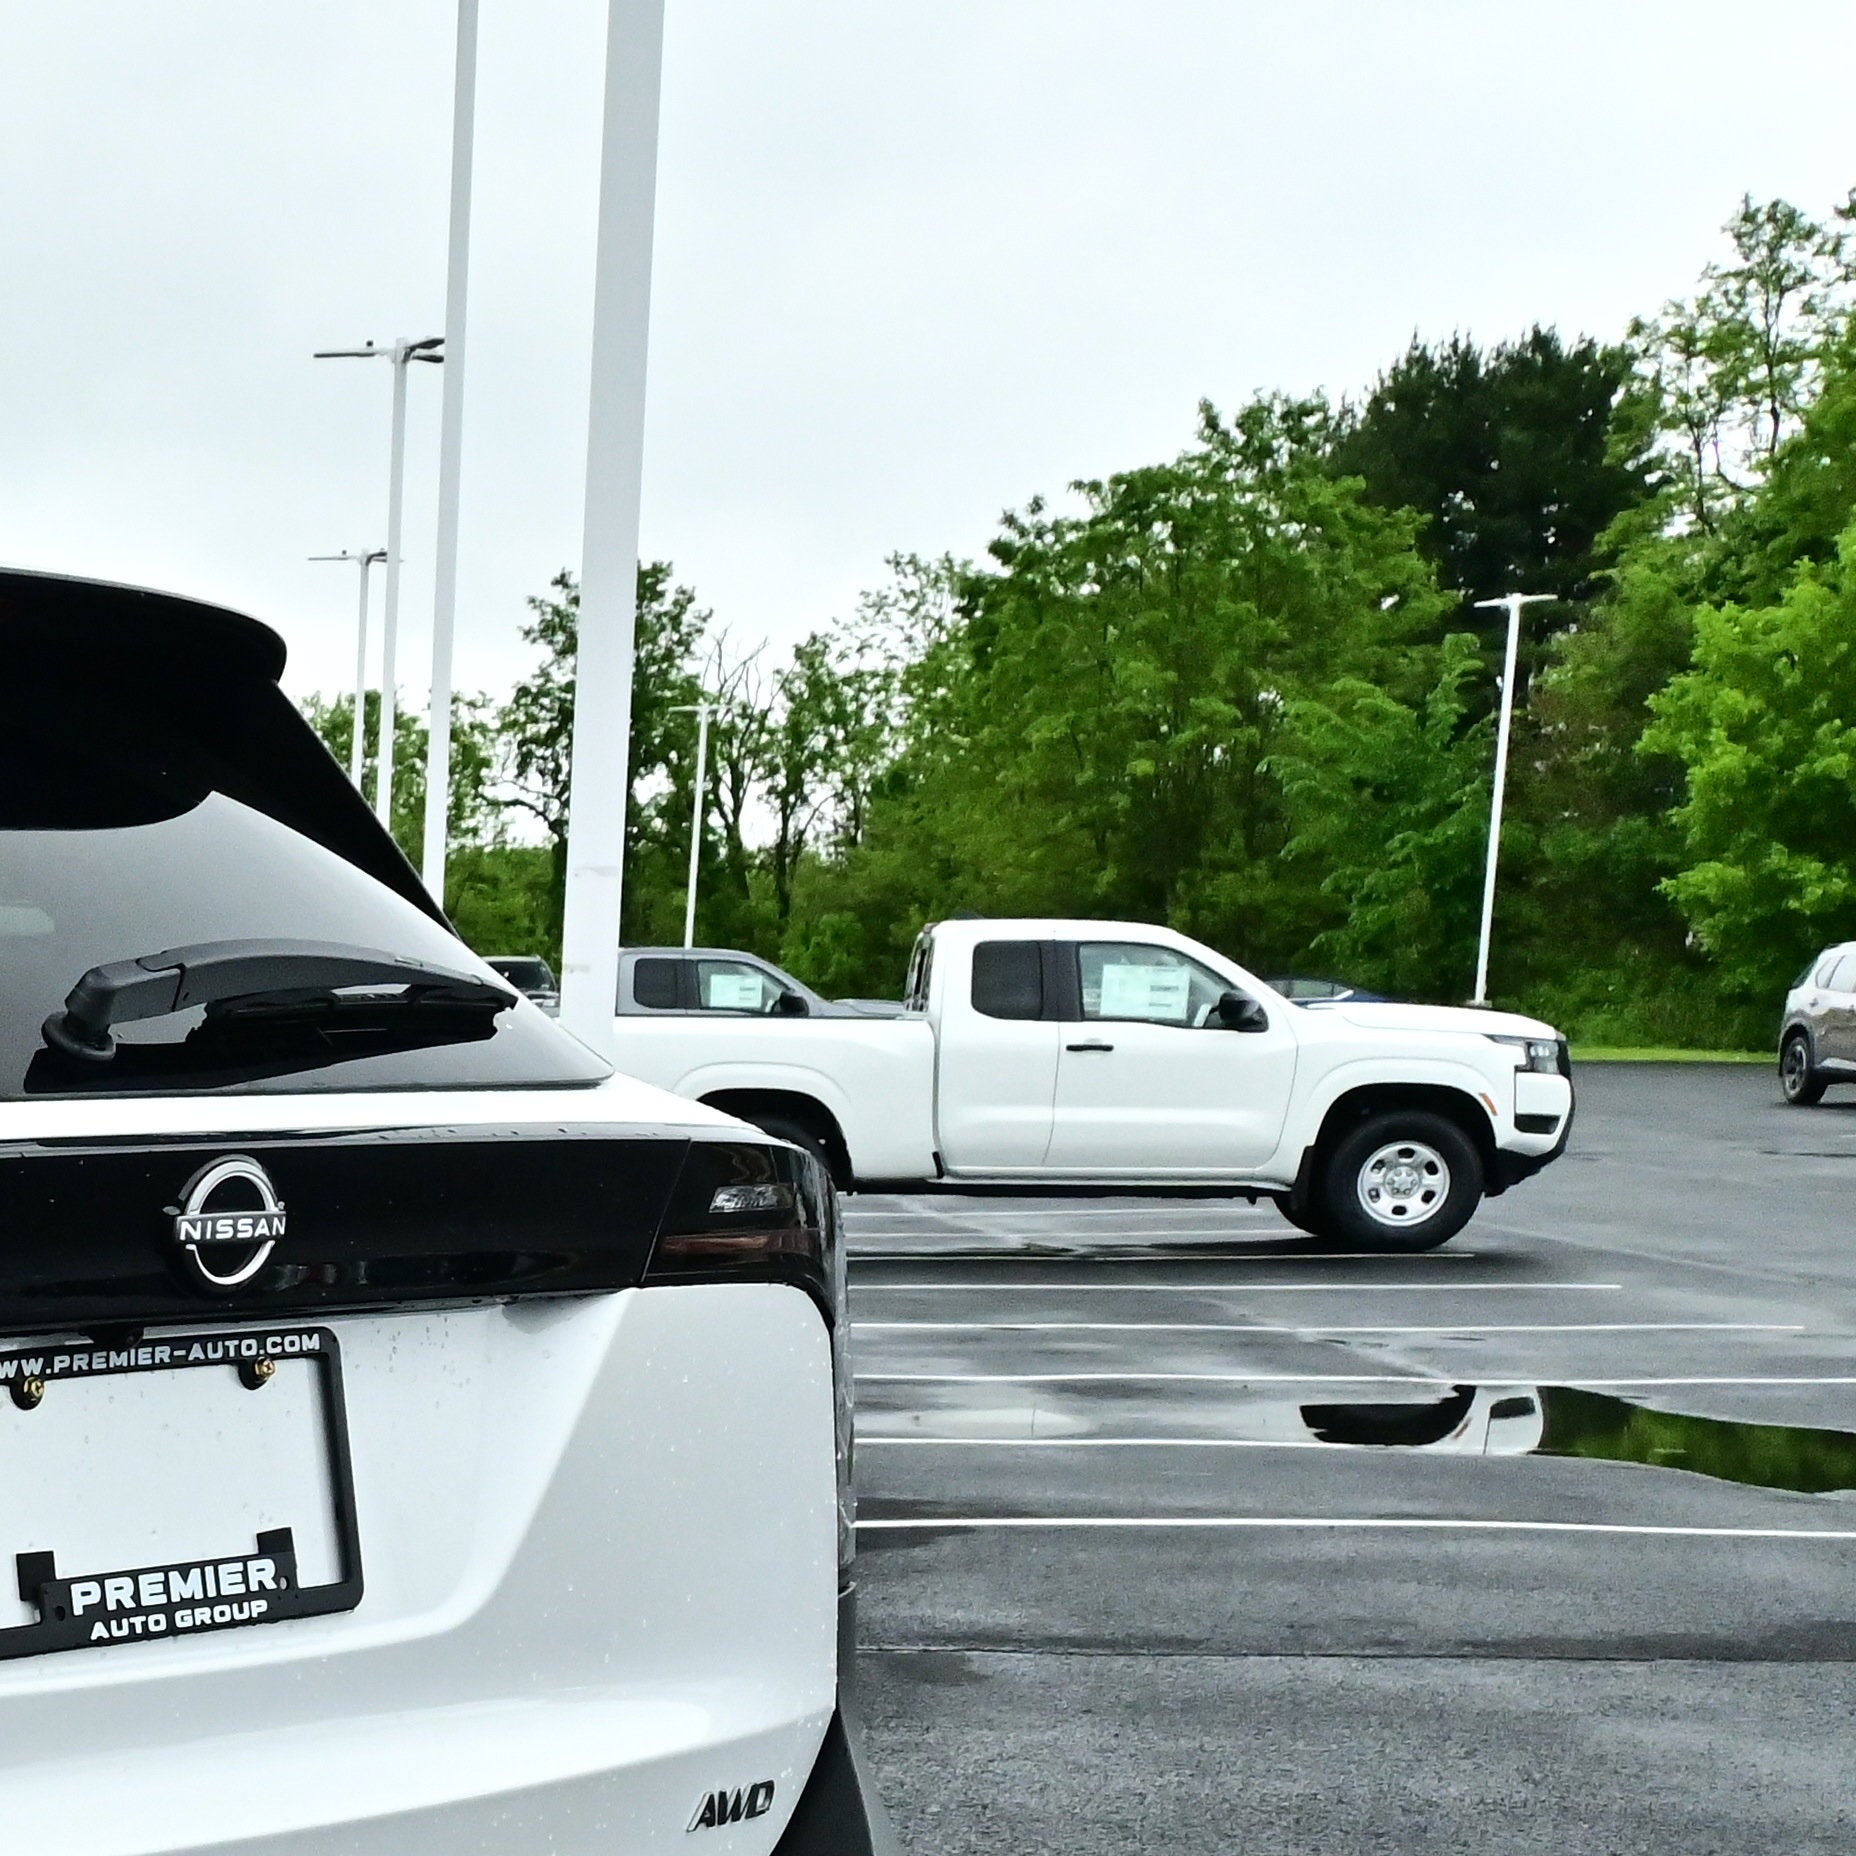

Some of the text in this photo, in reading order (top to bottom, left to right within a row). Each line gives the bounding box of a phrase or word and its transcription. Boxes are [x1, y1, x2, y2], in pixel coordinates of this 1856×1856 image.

[179, 1215, 286, 1241] NISSAN
[70, 1557, 277, 1616] PREMIER
[90, 1599, 268, 1640] AUTO GROUP
[686, 1779, 775, 1833] AWD
